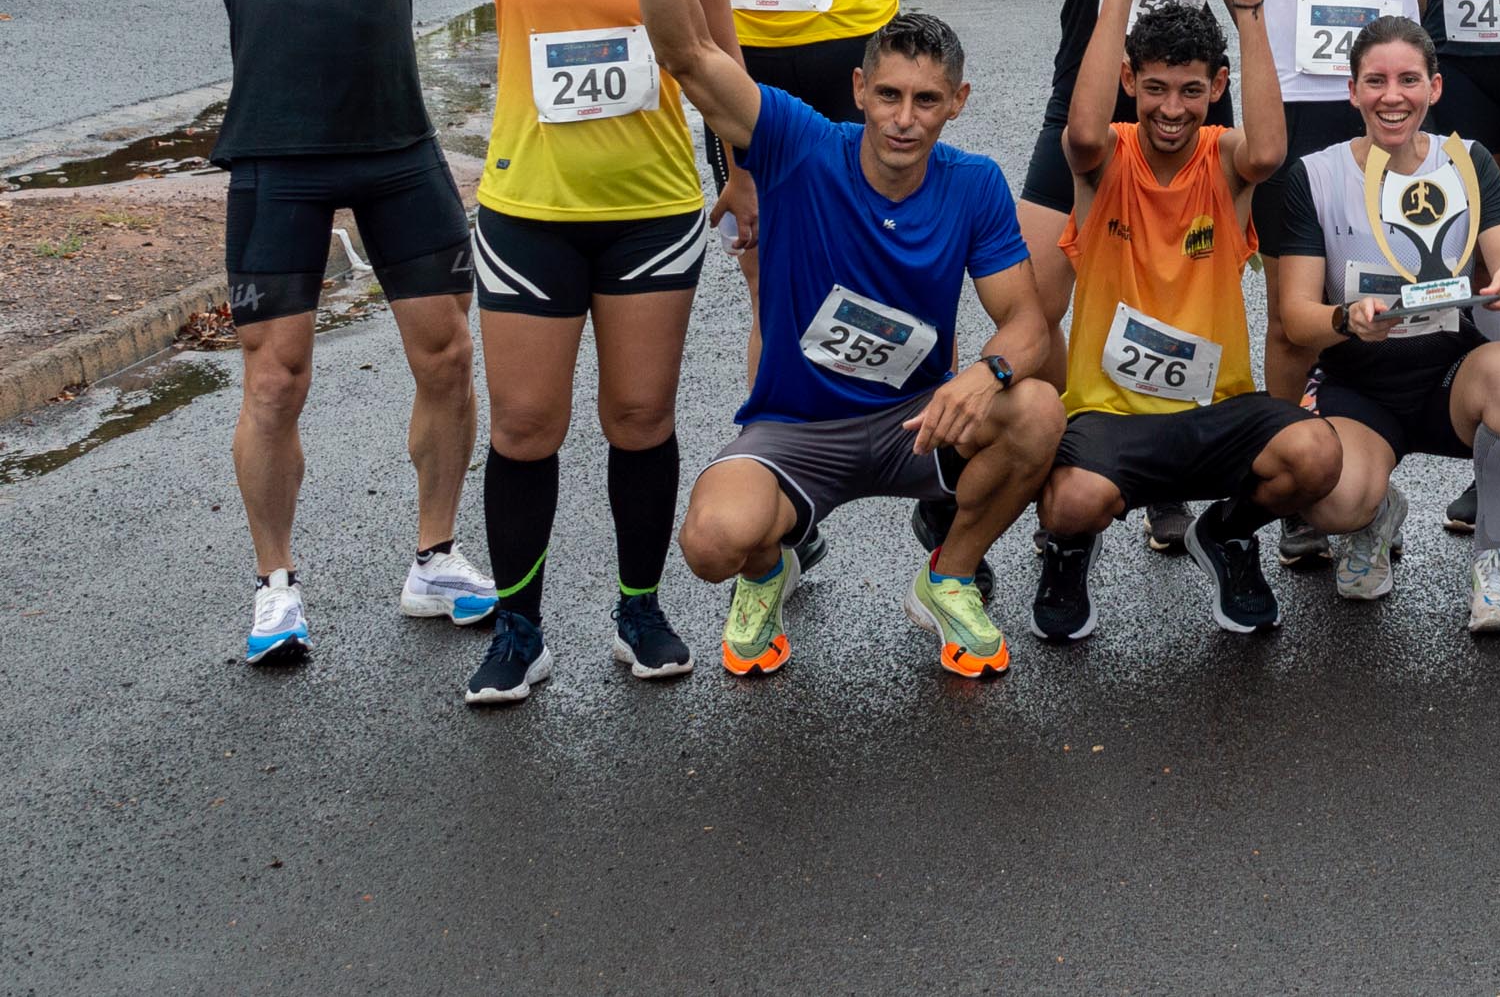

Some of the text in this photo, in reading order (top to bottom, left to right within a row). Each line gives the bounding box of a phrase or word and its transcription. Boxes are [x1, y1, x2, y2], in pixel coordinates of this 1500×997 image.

[1312, 29, 1354, 60] 24
[552, 66, 627, 106] 240
[820, 325, 897, 367] 255
[1116, 345, 1188, 387] 276
